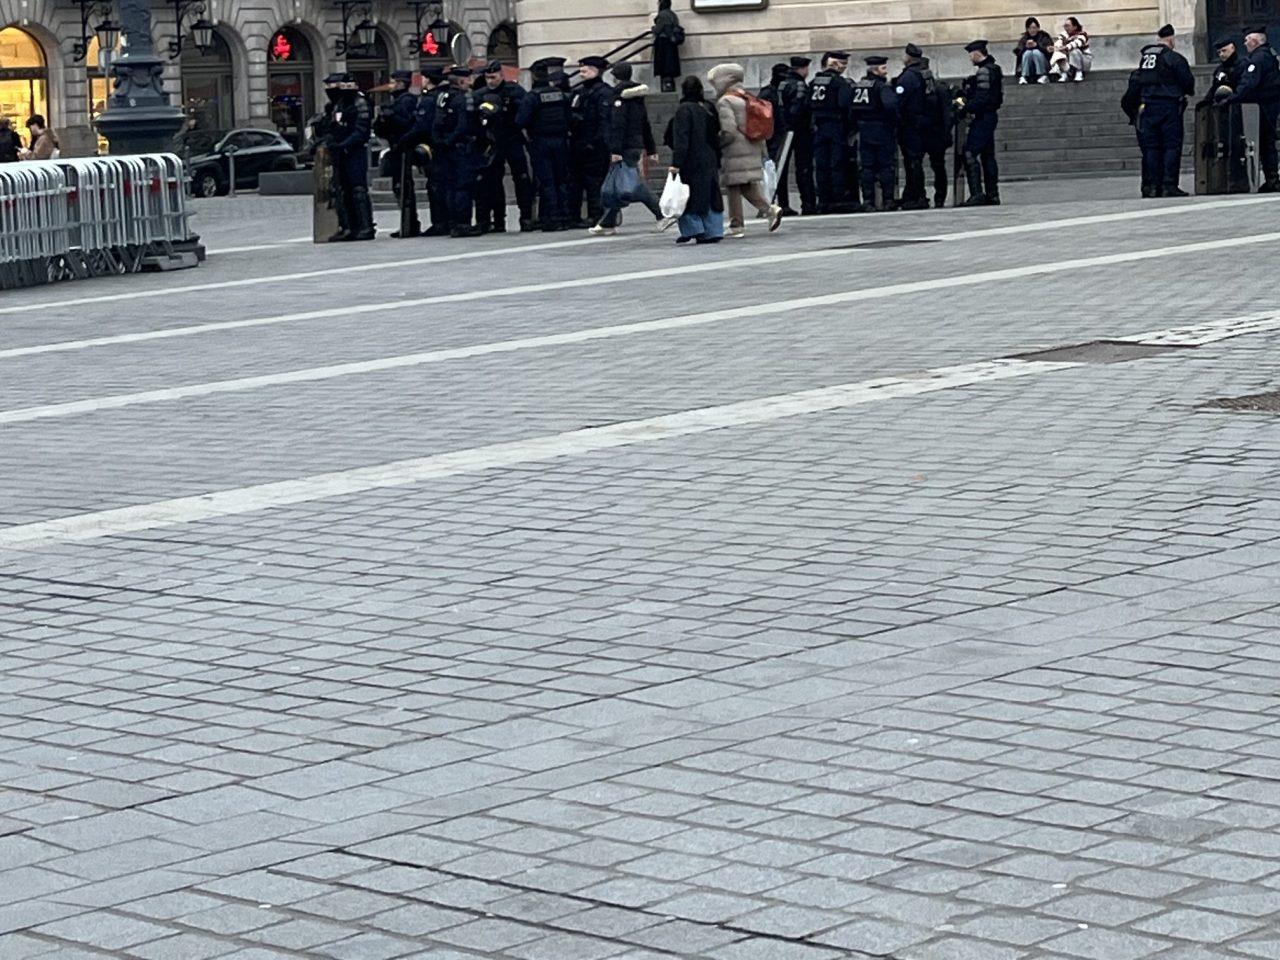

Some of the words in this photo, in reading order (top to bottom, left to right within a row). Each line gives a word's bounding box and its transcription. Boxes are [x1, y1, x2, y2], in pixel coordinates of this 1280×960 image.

[1141, 54, 1157, 69] 2B
[811, 86, 826, 101] 2C
[853, 88, 870, 104] 2A
